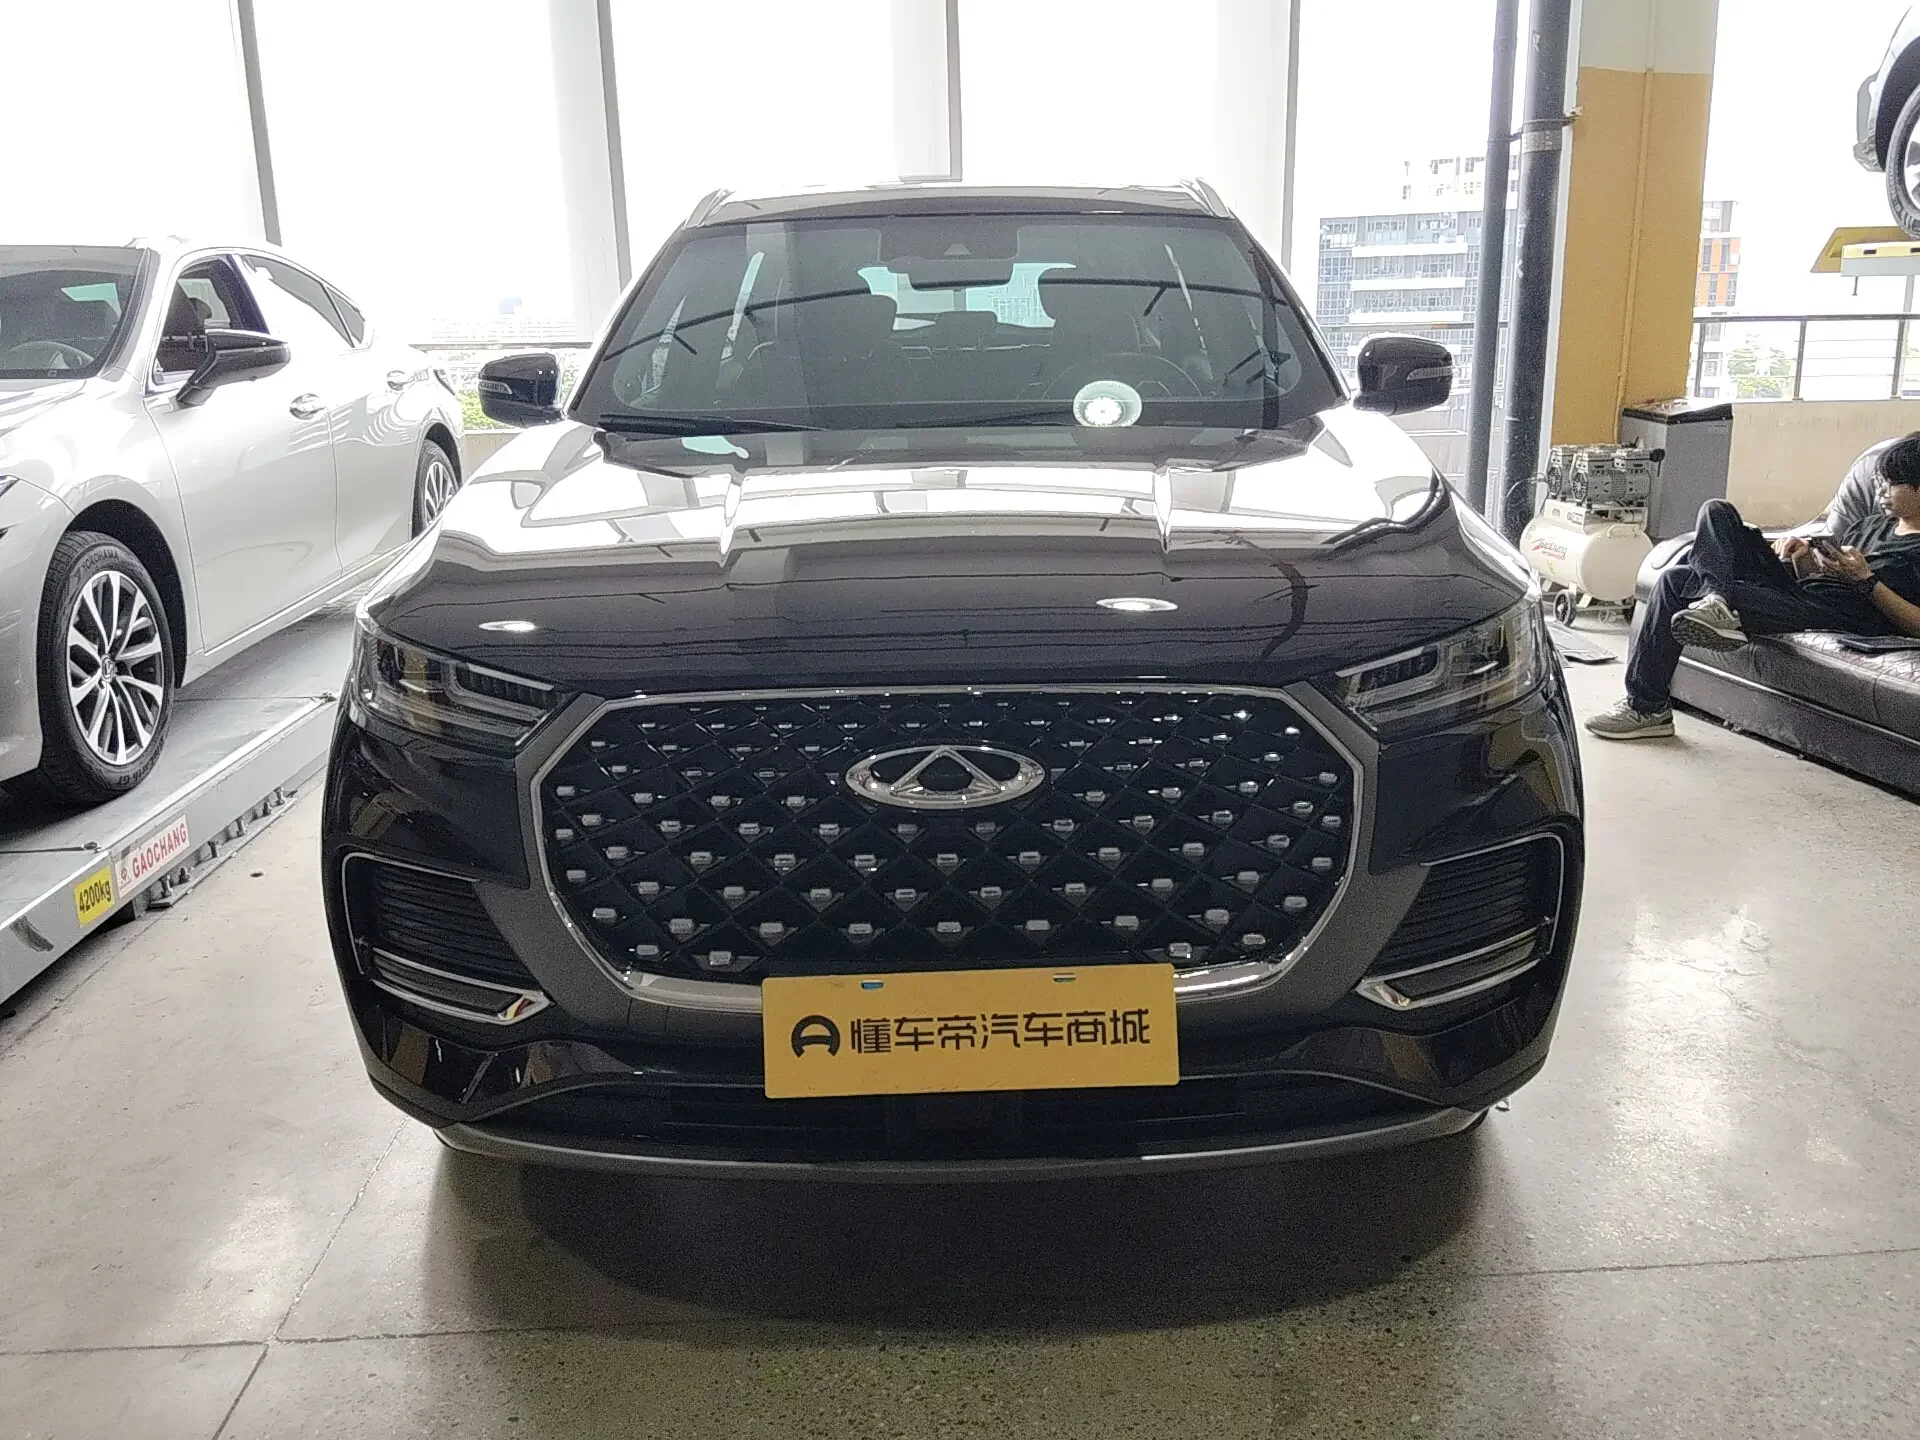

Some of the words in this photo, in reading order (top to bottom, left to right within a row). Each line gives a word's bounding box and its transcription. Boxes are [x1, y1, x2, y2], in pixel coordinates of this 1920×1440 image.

[132, 823, 187, 879] GAOCHANG
[79, 880, 112, 914] 4200kg
[850, 1008, 1151, 1054] 懂车帝汽车商城
